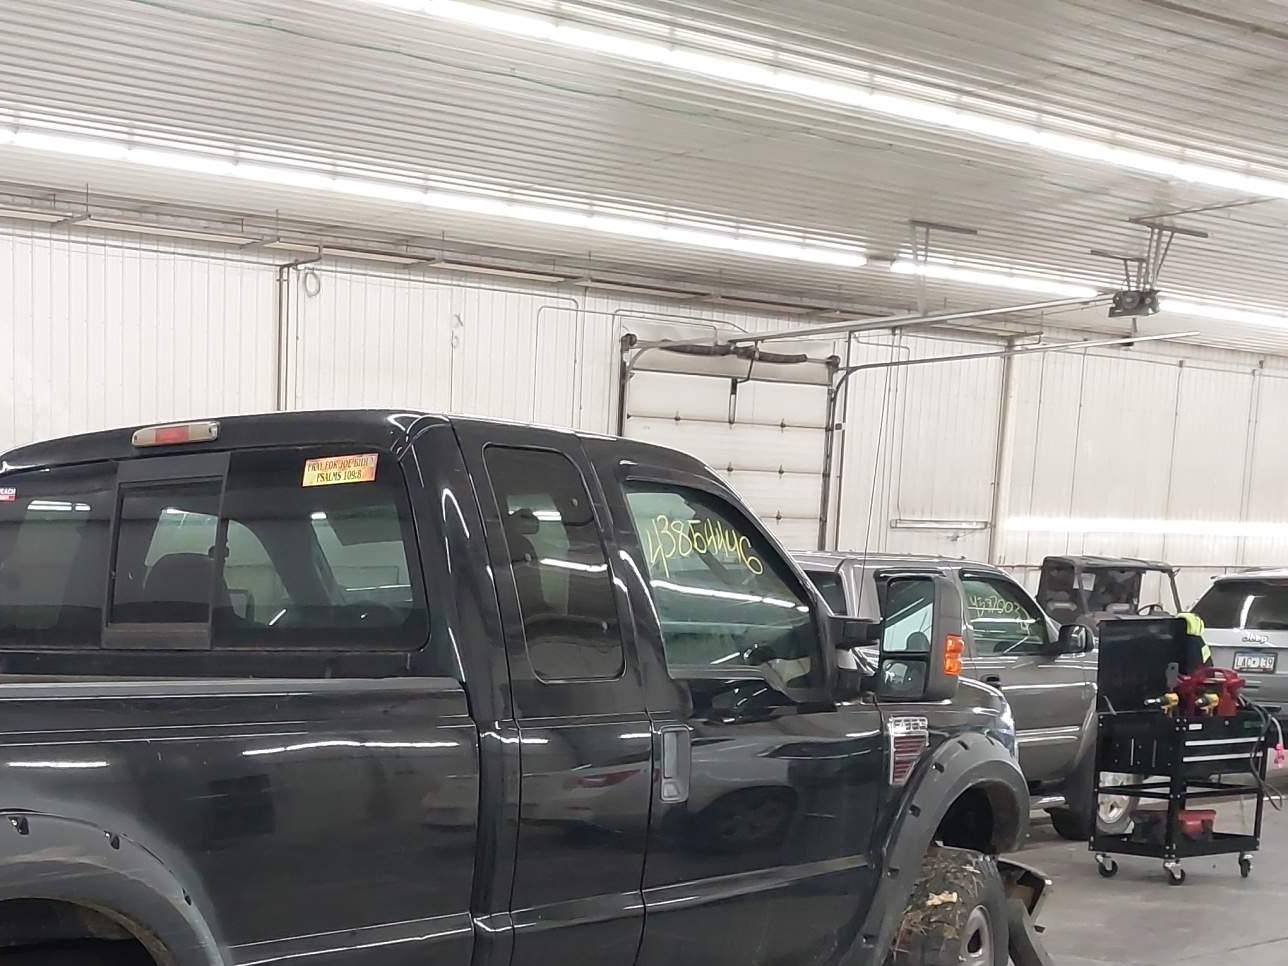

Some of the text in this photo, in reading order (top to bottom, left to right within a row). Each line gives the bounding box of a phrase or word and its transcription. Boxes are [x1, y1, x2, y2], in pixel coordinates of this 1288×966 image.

[316, 469, 362, 482] PSALMS 109:8
[646, 514, 764, 579] 43854446
